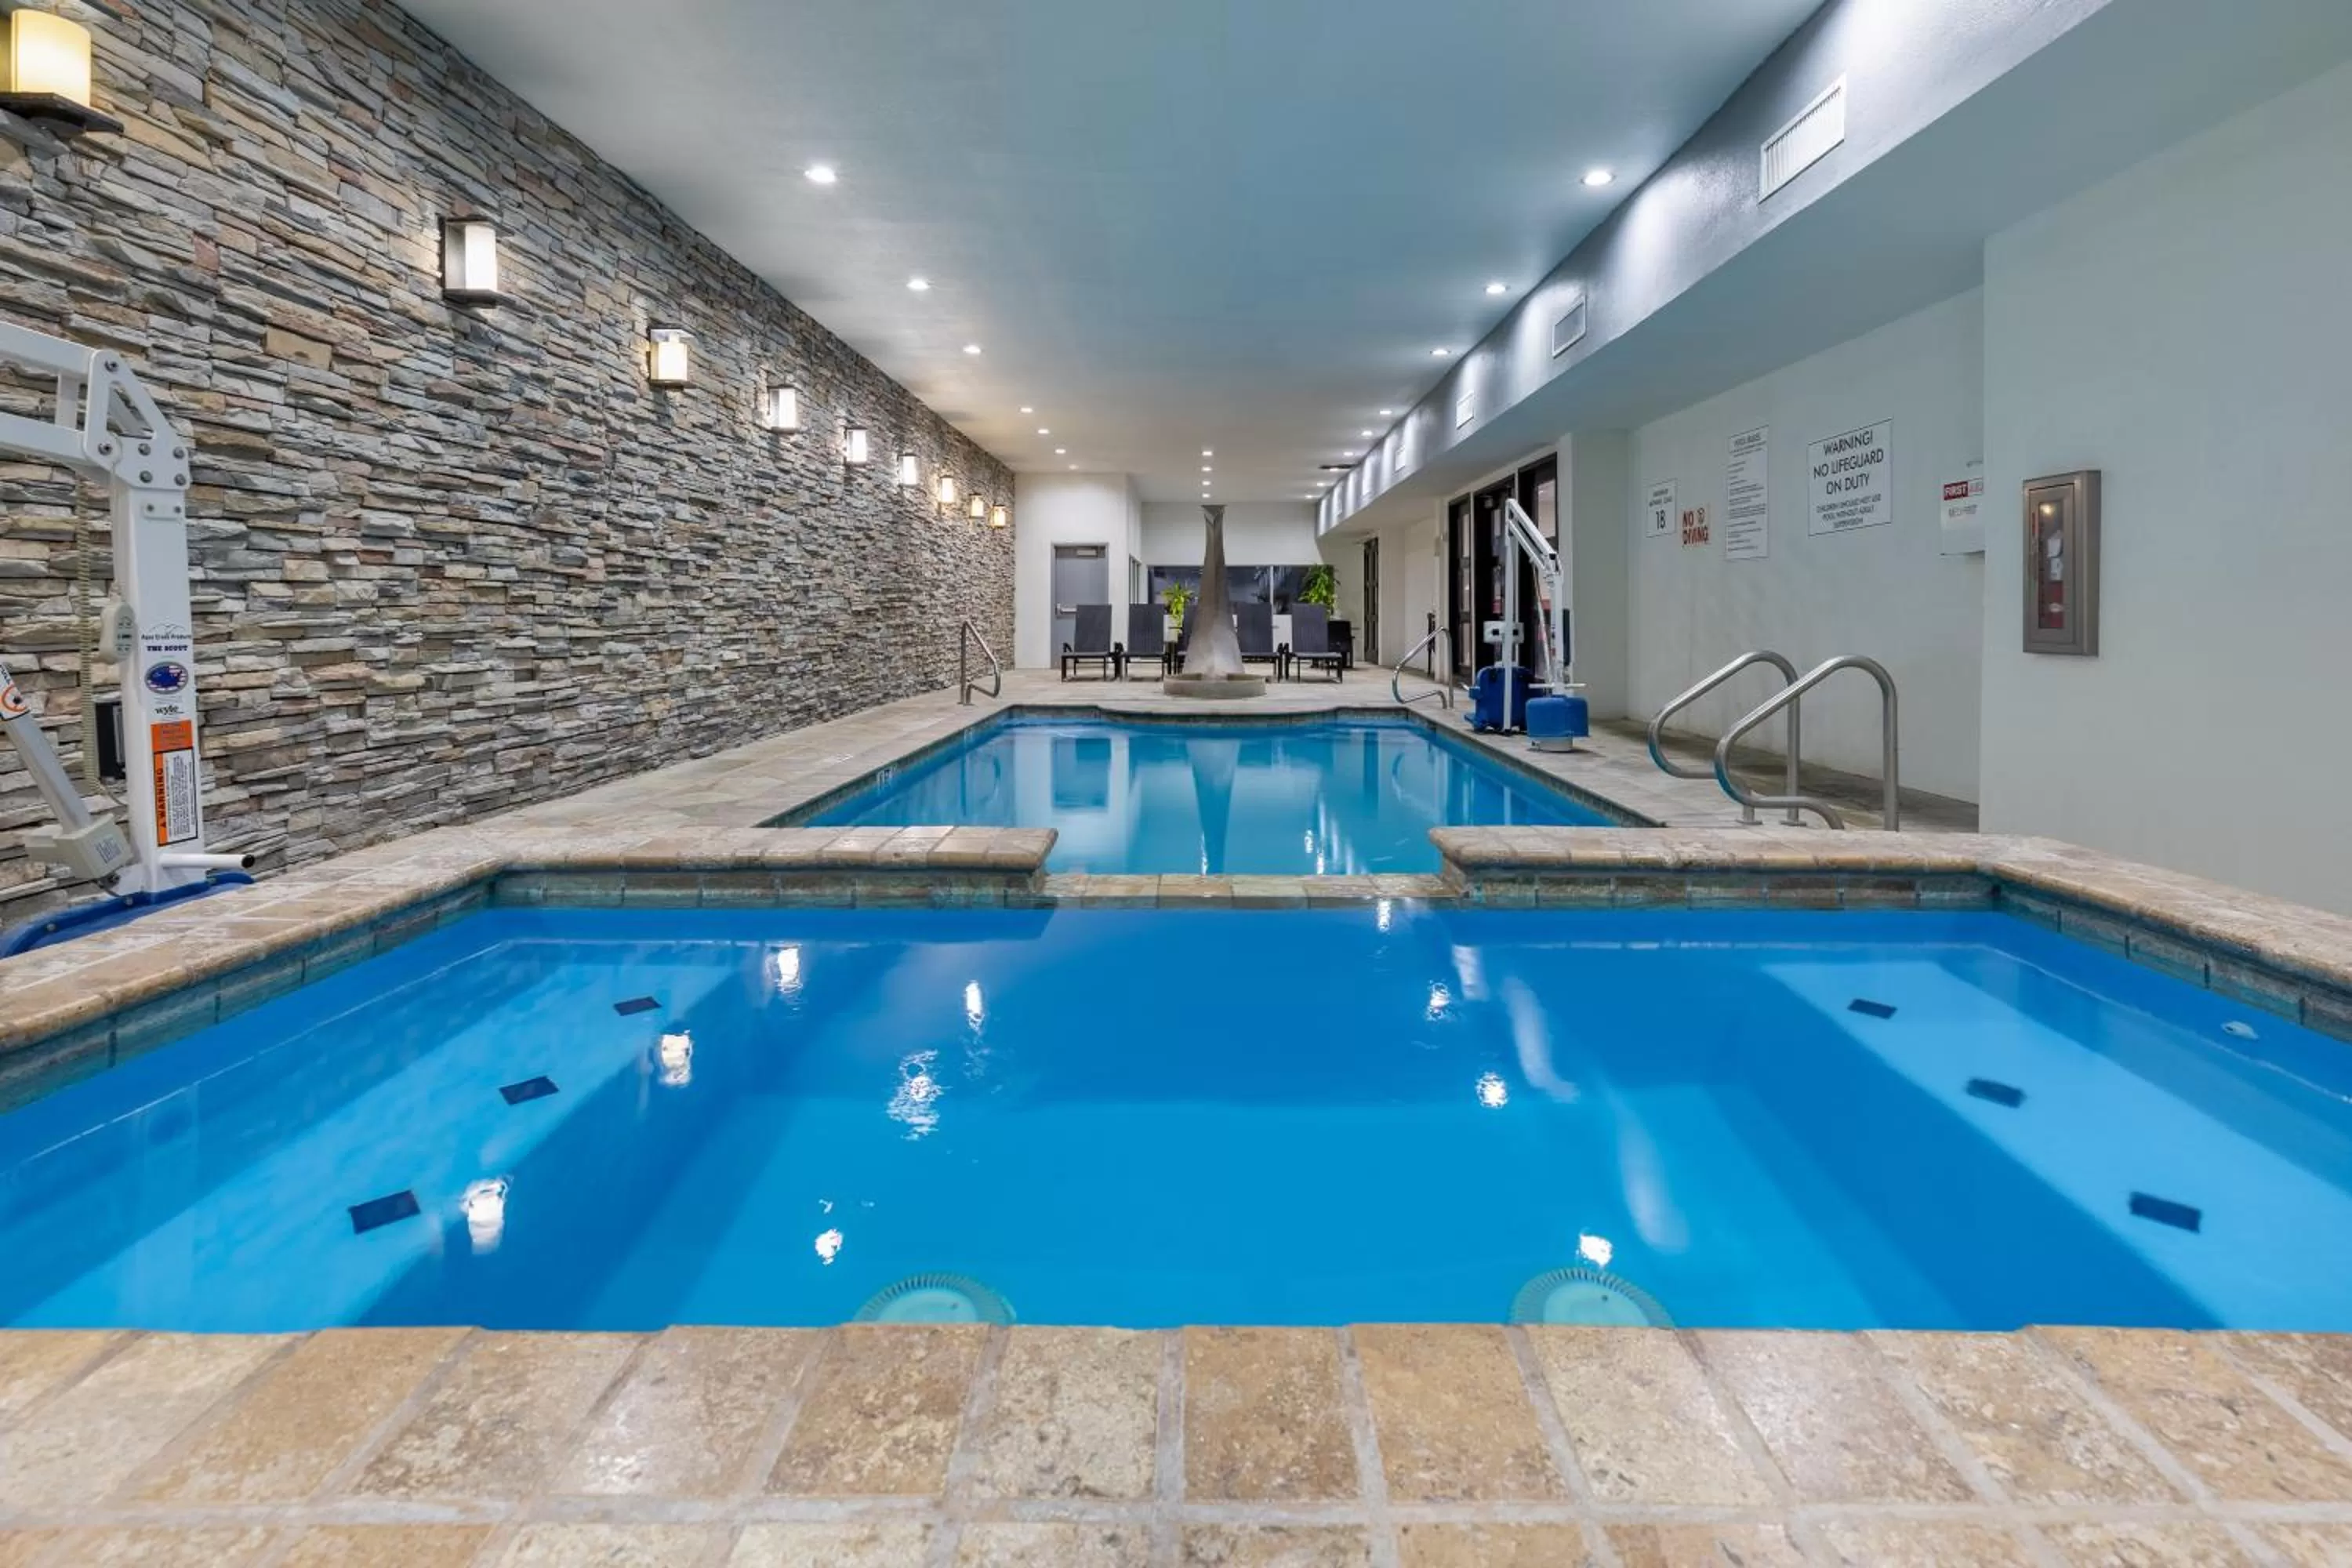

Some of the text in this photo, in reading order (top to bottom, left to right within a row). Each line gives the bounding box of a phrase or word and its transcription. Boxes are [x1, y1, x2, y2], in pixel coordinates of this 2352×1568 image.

[1823, 429, 1873, 455] WARNING!
[1813, 448, 1884, 479] NO LIFEGUARD
[1826, 473, 1870, 495] ON DUTY
[1945, 482, 1967, 499] FIRST
[1683, 510, 1694, 528] NO
[1682, 525, 1709, 545] DIVING
[157, 768, 167, 818] WARNING
